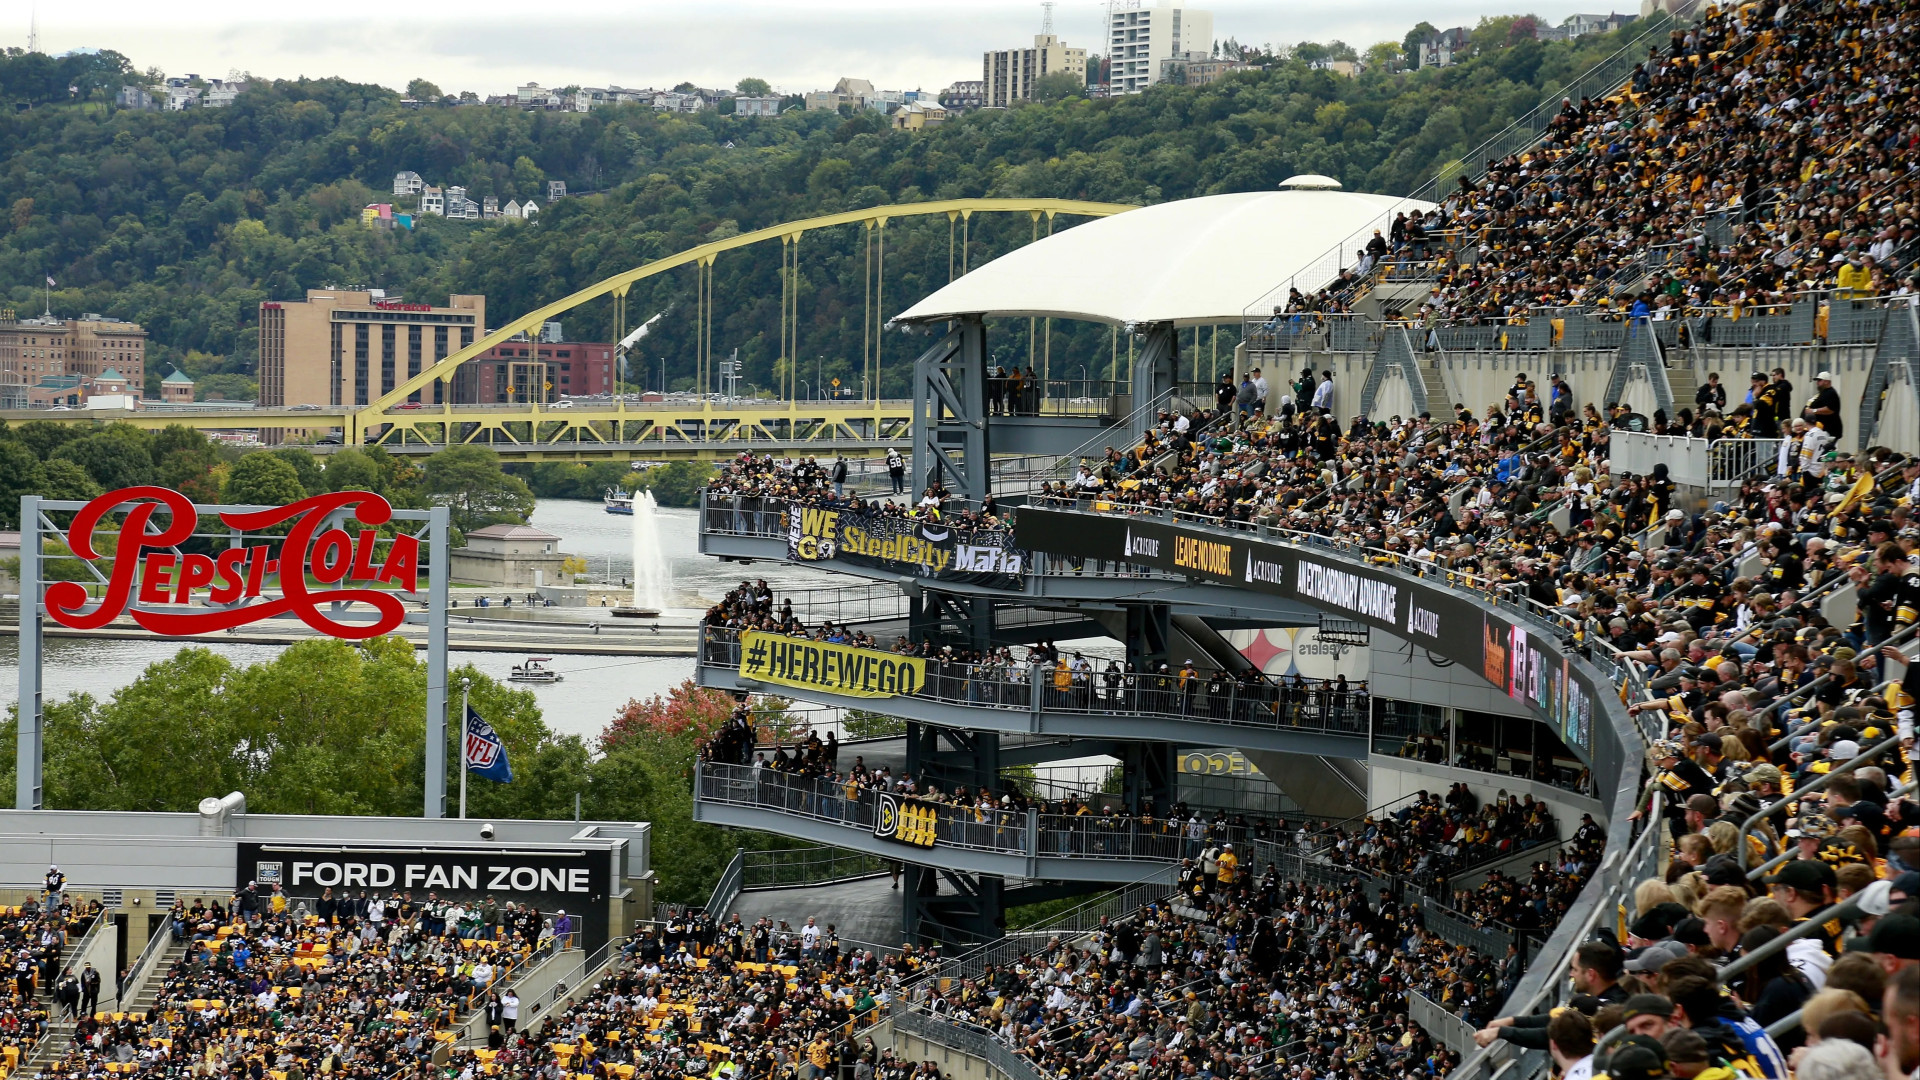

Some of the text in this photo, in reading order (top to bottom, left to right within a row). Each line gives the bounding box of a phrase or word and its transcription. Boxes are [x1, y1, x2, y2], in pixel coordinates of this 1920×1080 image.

[375, 301, 431, 312] Sheraton
[890, 457, 902, 468] 58
[788, 505, 801, 550] HERE
[802, 508, 839, 539] WE
[1132, 536, 1160, 558] ACRISURE
[1174, 535, 1232, 576] LEAVE NO DOUBT.
[1253, 559, 1283, 584] ACRISURE
[1297, 560, 1397, 625] AN EXTRAORDINARY ADVANTAGE
[1414, 607, 1440, 638] ACRISURE
[746, 638, 915, 696] #HEREWEGO
[466, 733, 493, 763] NFL
[1193, 827, 1199, 837] 6
[260, 863, 279, 871] BUILT
[49, 876, 58, 886] 90
[292, 861, 590, 893] FORD FAN ZONE
[1182, 870, 1192, 881] 97
[388, 901, 399, 909] 30
[424, 902, 433, 910] 86
[728, 926, 737, 936] 43
[803, 933, 813, 943] 43
[816, 1049, 824, 1058] 55
